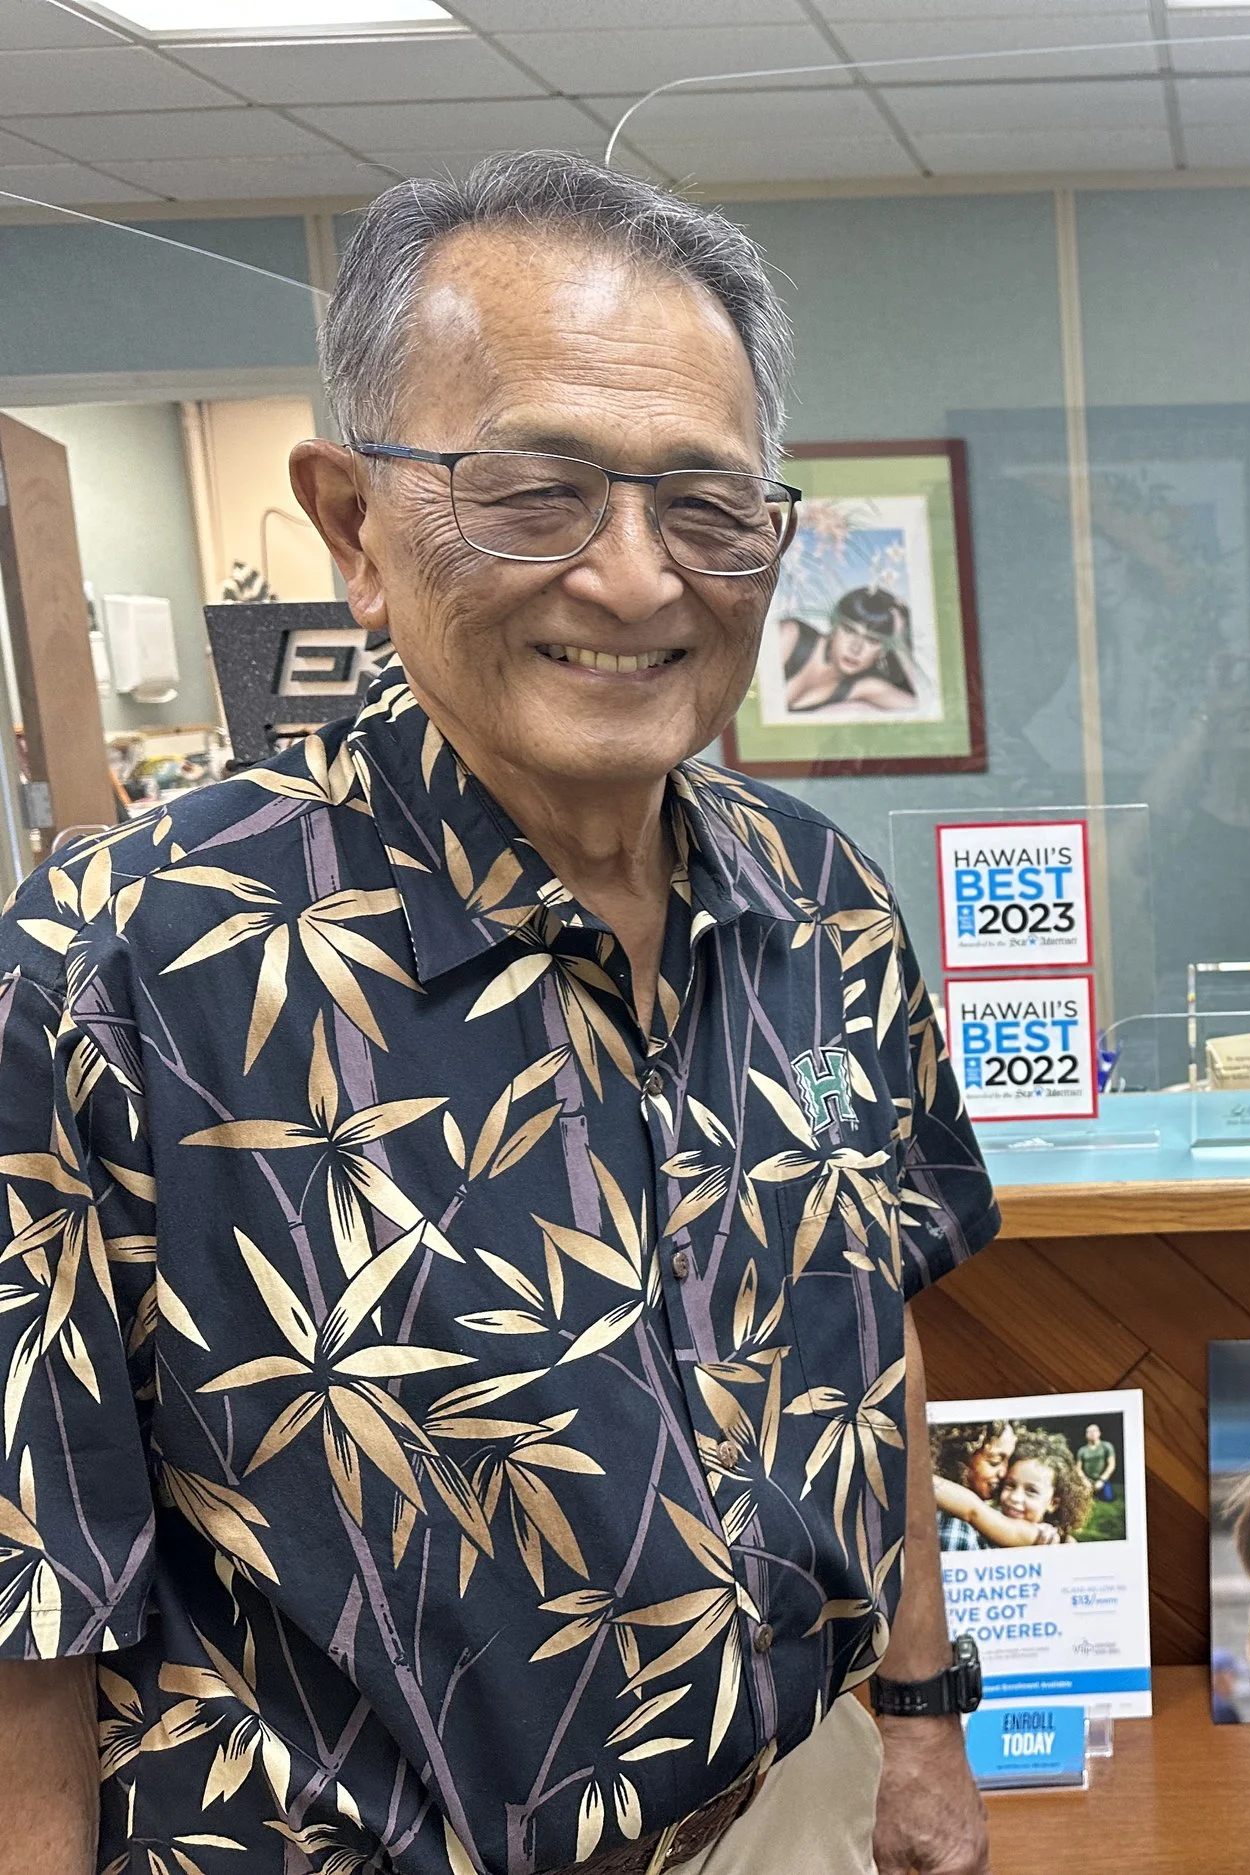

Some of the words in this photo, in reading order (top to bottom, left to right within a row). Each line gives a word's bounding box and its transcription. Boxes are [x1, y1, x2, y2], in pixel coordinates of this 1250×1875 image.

[954, 847, 1073, 868] HAWAII'S
[954, 866, 1073, 903] BEST
[978, 902, 1076, 935] 2023
[961, 1000, 1078, 1021] HAWAII'S
[962, 1019, 1079, 1055] BEST
[985, 1054, 1080, 1086] 2022
[943, 1567, 969, 1583] ED
[974, 1562, 1042, 1582] VISION
[946, 1582, 1041, 1604] URANCE?
[948, 1606, 981, 1623] 'VE
[986, 1603, 1028, 1621] GOT
[1003, 1711, 1056, 1731] ENROLL
[1001, 1731, 1056, 1757] TODAY
